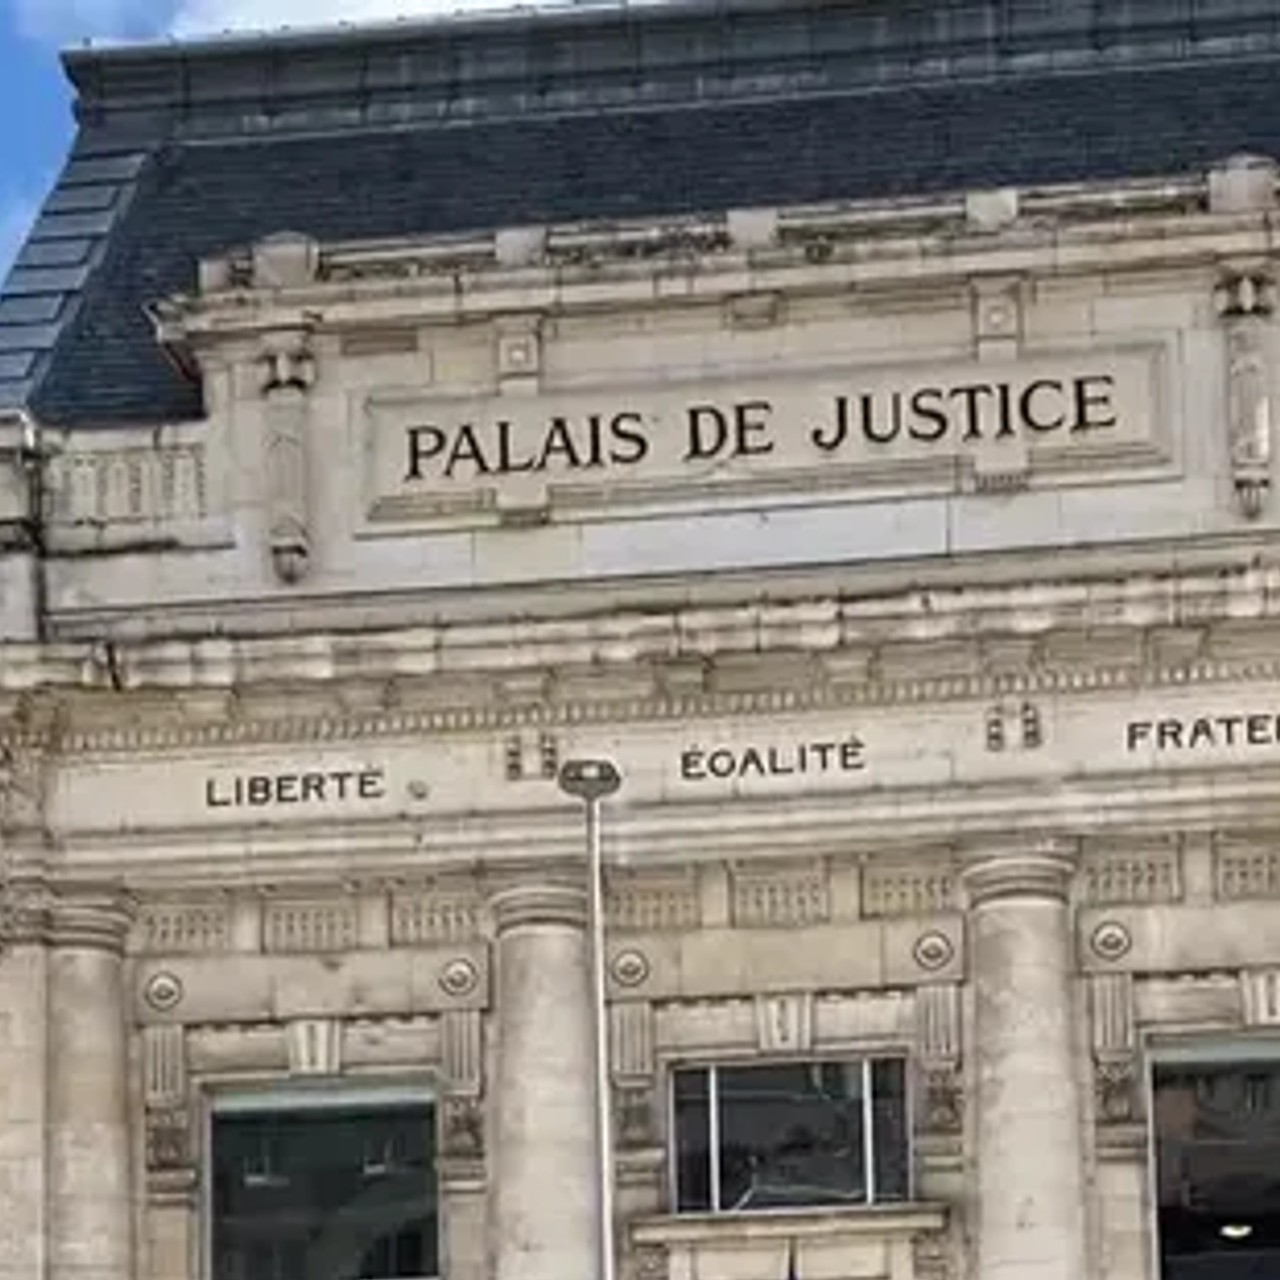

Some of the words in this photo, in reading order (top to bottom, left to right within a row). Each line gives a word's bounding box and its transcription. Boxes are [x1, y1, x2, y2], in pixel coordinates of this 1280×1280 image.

[404, 411, 650, 482] PALAIS
[682, 400, 775, 463] DE
[811, 375, 1118, 451] JUSTICE
[205, 764, 387, 807] LIBERTÉ
